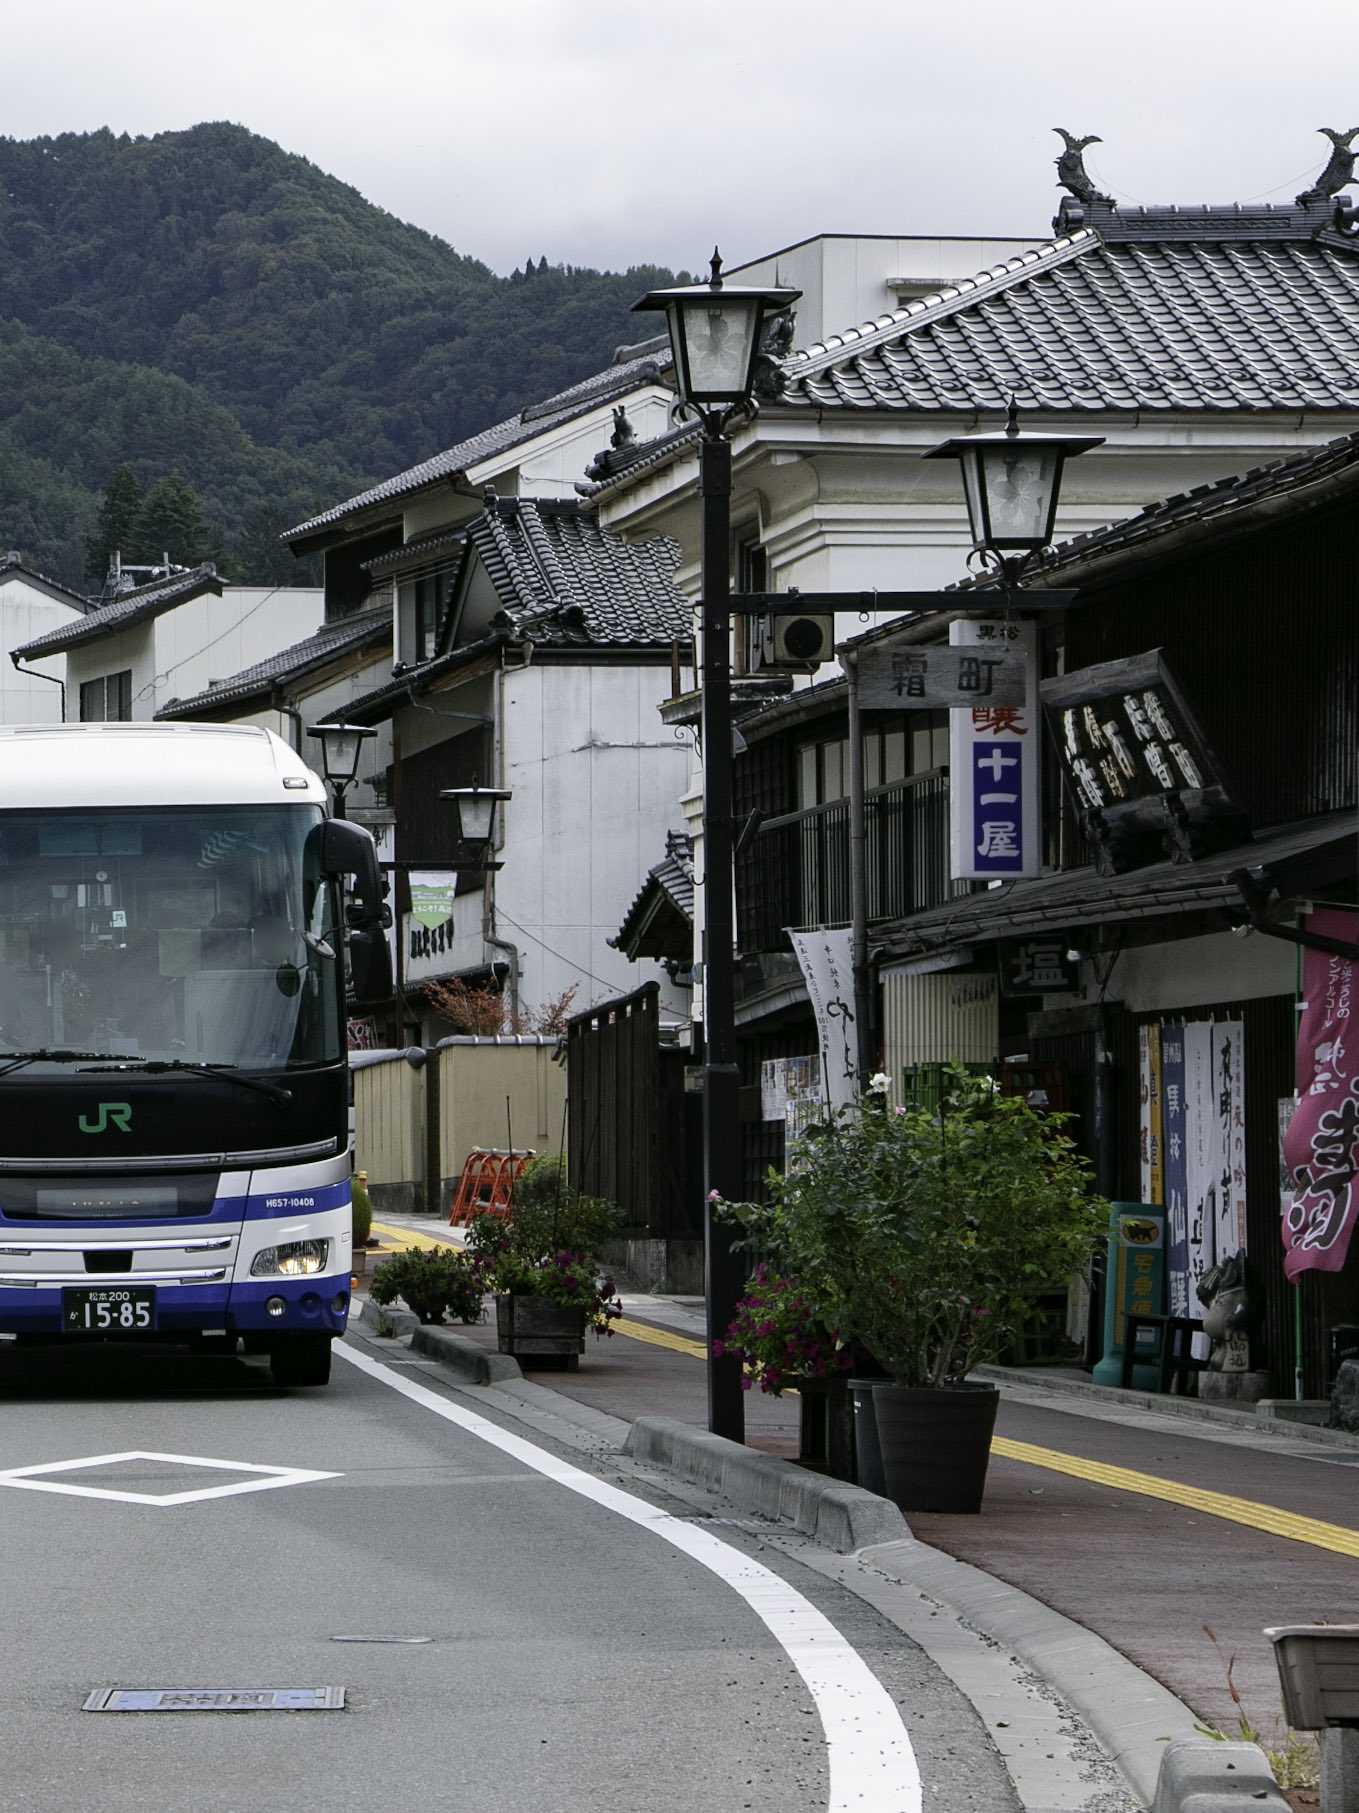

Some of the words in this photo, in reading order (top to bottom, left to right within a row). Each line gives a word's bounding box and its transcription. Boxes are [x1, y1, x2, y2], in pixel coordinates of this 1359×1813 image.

[976, 625, 1021, 641] 黒松
[891, 652, 1004, 698] 霜町
[976, 748, 1021, 859] 十一屋
[1011, 942, 1069, 986] 塩
[78, 1102, 133, 1134] JR
[88, 1291, 130, 1301] 松本200
[84, 1302, 151, 1328] 15-85
